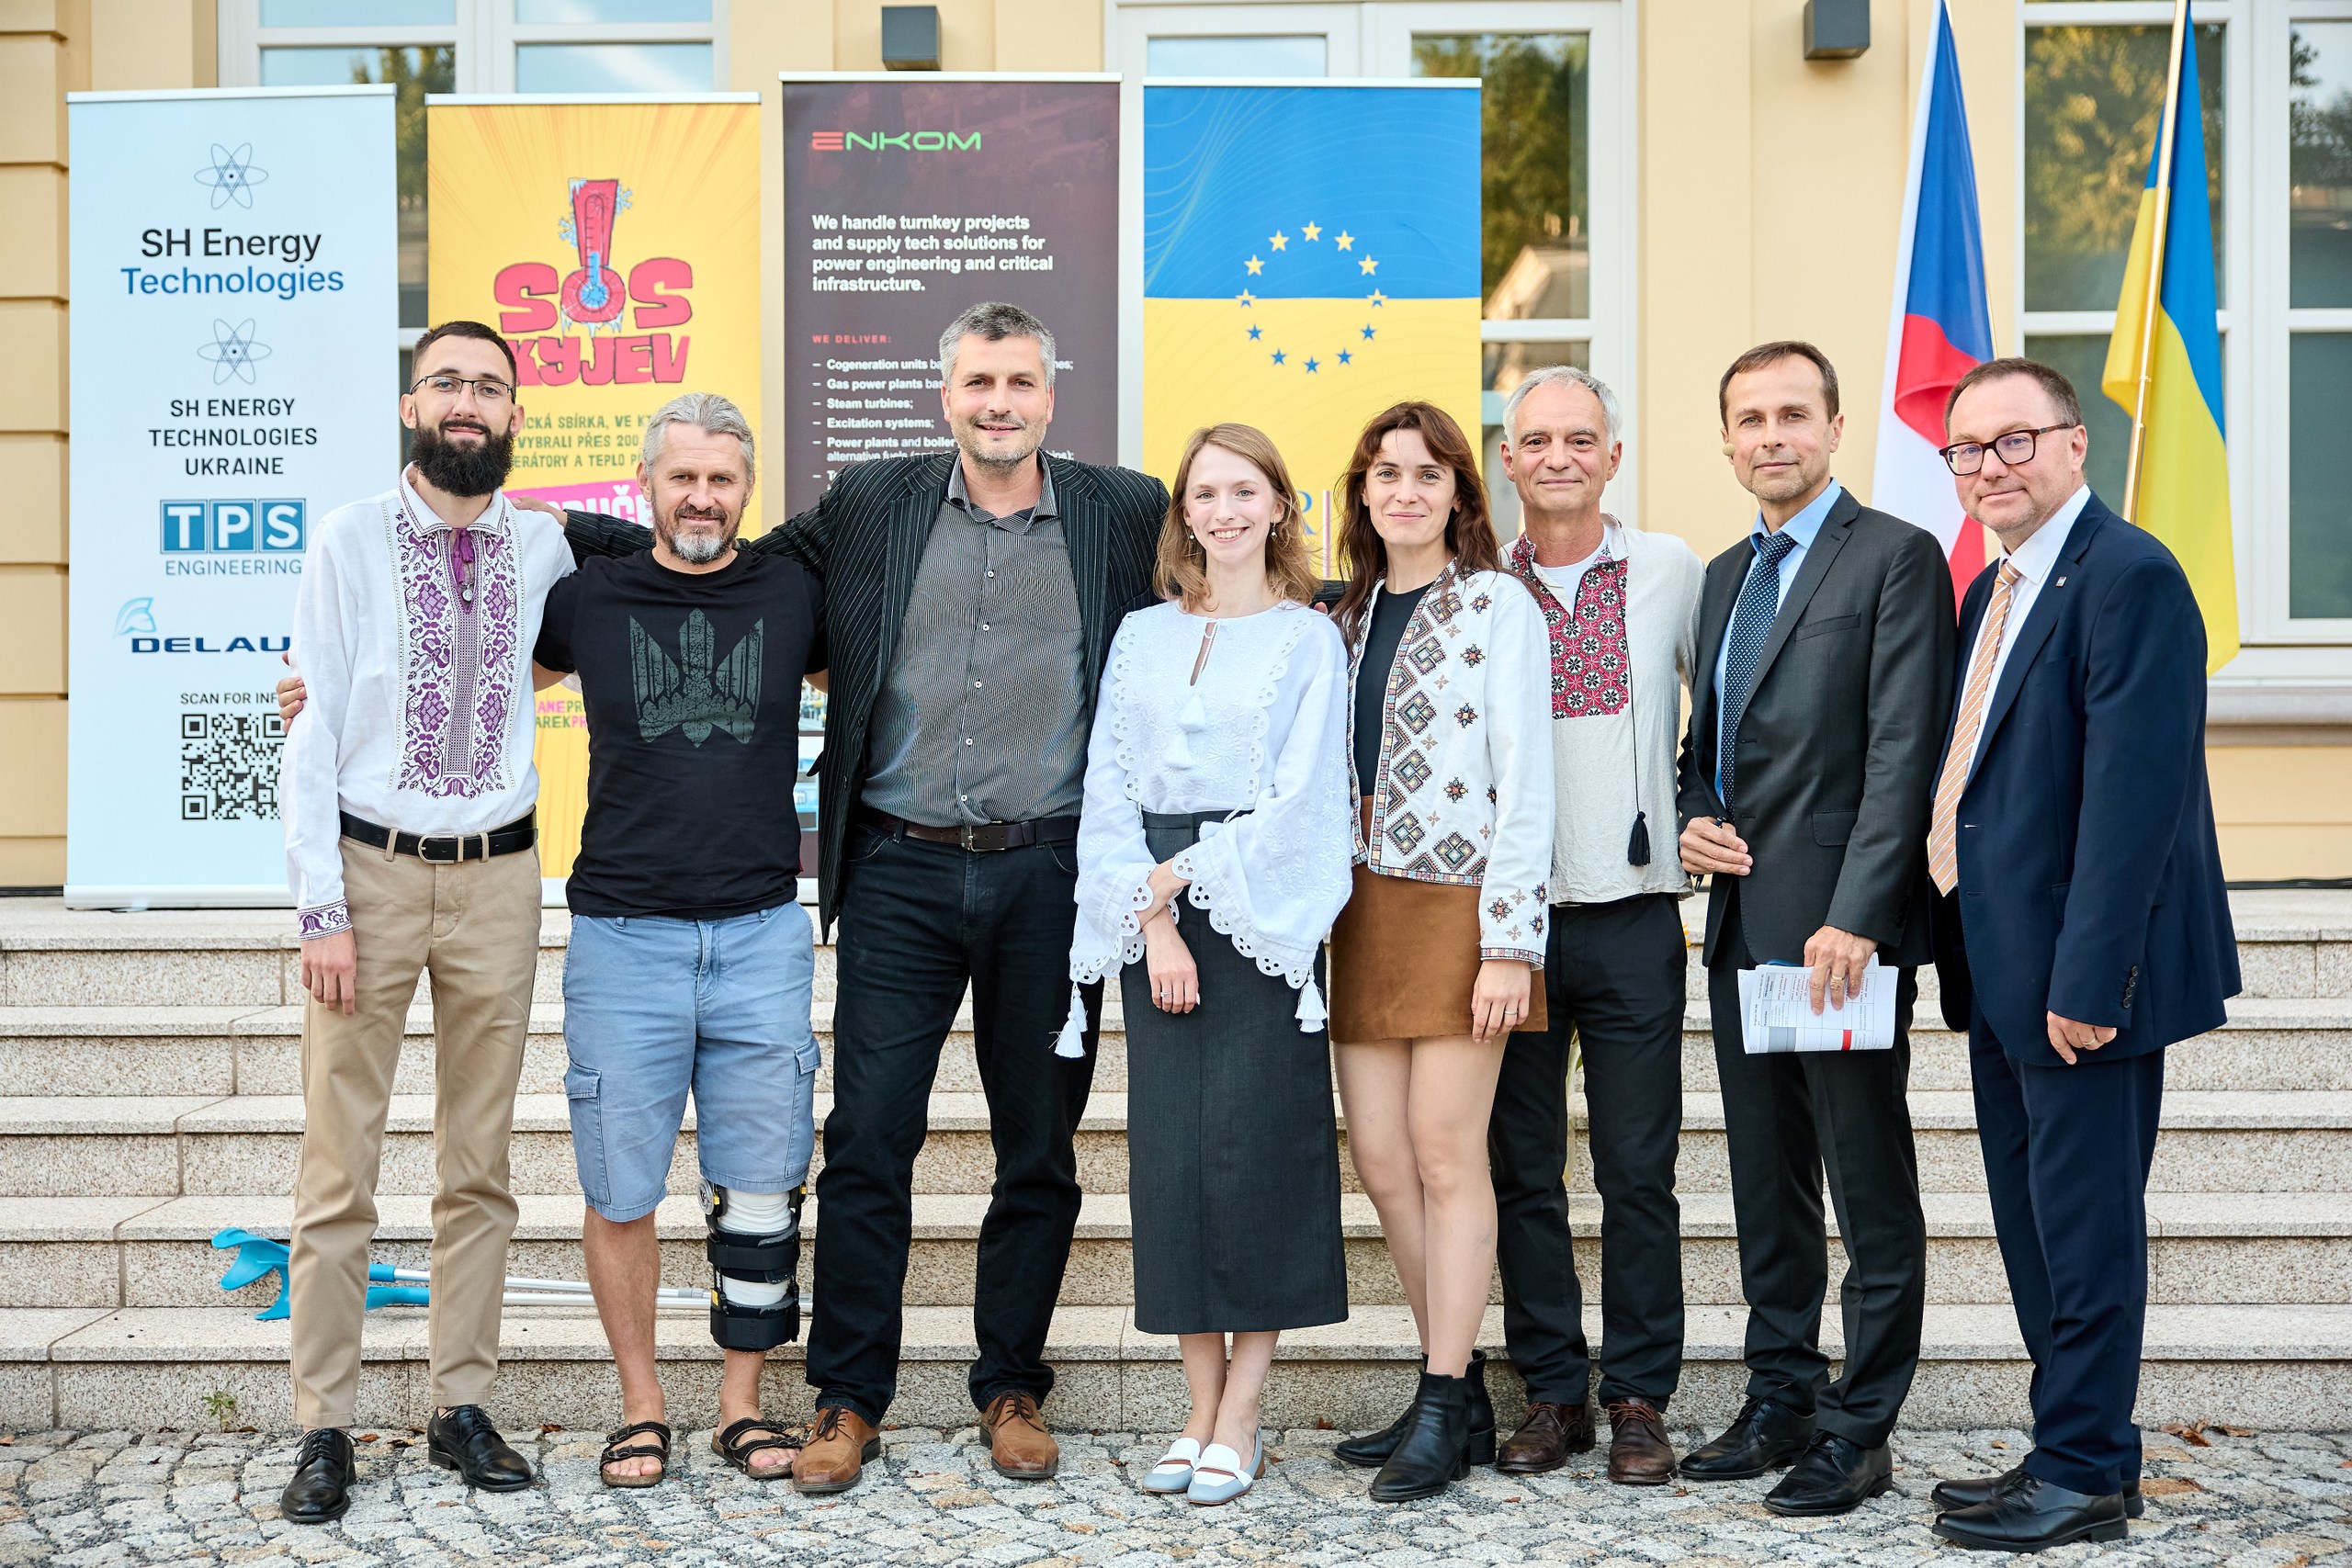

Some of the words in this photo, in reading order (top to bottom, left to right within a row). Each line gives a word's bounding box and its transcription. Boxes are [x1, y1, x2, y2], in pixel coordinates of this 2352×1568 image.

[811, 131, 982, 151] ENKOM
[811, 214, 839, 230] We
[842, 214, 897, 230] handle
[899, 214, 962, 233] turnkey
[965, 214, 1031, 233] projects
[141, 229, 190, 257] SH
[204, 228, 322, 263] Energy
[811, 235, 843, 251] and
[846, 235, 901, 254] supply
[904, 235, 940, 251] tech
[943, 234, 1019, 251] solutions
[1021, 234, 1046, 251] for
[812, 258, 864, 275] power
[865, 255, 962, 275] engineering
[965, 255, 996, 271] and
[999, 255, 1054, 271] critical
[120, 264, 345, 300] Technologies
[812, 276, 926, 292] infrastructure.
[812, 334, 830, 344] WE
[835, 334, 892, 344] DELIVER:
[827, 358, 899, 372] Cogeneration
[900, 358, 928, 370] units
[827, 378, 850, 389] Gas
[852, 379, 887, 391] power
[888, 378, 923, 391] plants
[170, 399, 199, 417] SH
[208, 398, 295, 416] ENERGY
[827, 398, 863, 410] Steam
[865, 397, 914, 410] turbines;
[558, 412, 609, 429] SBÍRKA,
[615, 415, 631, 427] VE
[827, 417, 883, 429] Excitation
[885, 418, 934, 430] systems;
[148, 427, 317, 447] TECHNOLOGIES
[518, 436, 571, 448] VYBRALI
[578, 433, 611, 448] PŘES
[616, 434, 639, 446] 200
[827, 436, 863, 448] Power
[865, 436, 899, 449] plants
[900, 436, 922, 448] and
[923, 435, 956, 448] boiler
[186, 457, 284, 476] UKRAINE
[514, 452, 569, 468] ERÁTORY
[574, 456, 582, 468] A
[588, 454, 625, 467] TEPLO
[167, 504, 300, 549] TPS
[165, 558, 302, 576] ENGINEERING
[131, 636, 291, 653] DELAU
[180, 693, 220, 705] SCAN
[224, 693, 251, 704] FOR
[255, 693, 278, 704] INF
